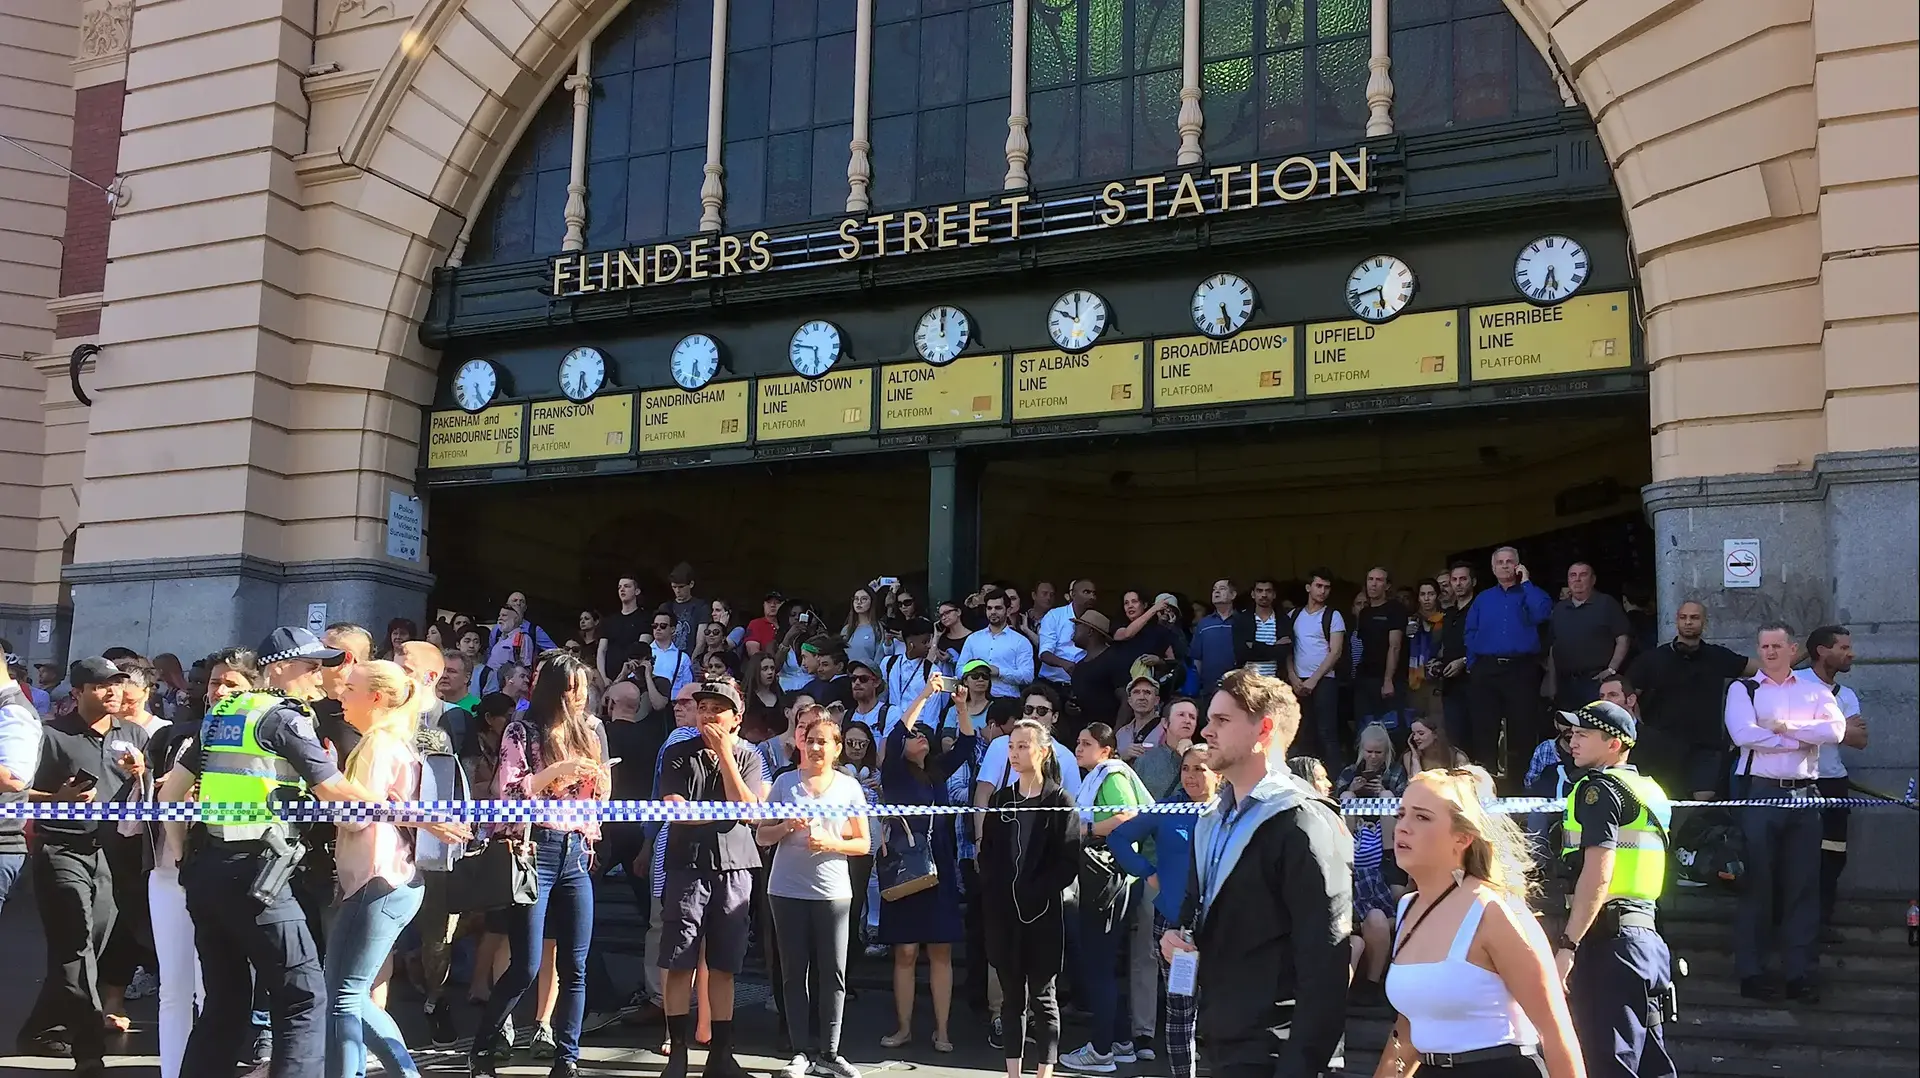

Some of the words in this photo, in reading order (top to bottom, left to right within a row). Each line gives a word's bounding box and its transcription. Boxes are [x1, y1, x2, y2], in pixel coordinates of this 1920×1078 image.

[553, 230, 773, 296] FLINDERS
[838, 195, 1030, 260] STREET
[1101, 147, 1368, 226] STATION
[1479, 306, 1563, 329] WERRIBEE
[1314, 326, 1375, 345] UPFIELD
[1479, 333, 1514, 350] LINE
[1160, 335, 1283, 360] BROADMEADOWS
[1019, 359, 1035, 373] ST
[1038, 355, 1089, 371] ALBANS
[1314, 348, 1346, 365] LINE
[1480, 353, 1541, 369] PLATFORM
[888, 368, 936, 384] ALTONA
[1161, 363, 1191, 379] LINE
[1314, 370, 1370, 384] PLATFORM
[765, 377, 852, 397] WILLIAMSTOWN
[1019, 377, 1047, 392] LINE
[1161, 383, 1213, 397] PLATFORM
[1569, 382, 1588, 391] FOR
[645, 389, 725, 409] SANDRINGHAM
[887, 388, 913, 402] LINE
[1019, 396, 1068, 409] PLATFORM
[533, 404, 594, 420] FRANKSTON
[763, 400, 788, 414] LINE
[887, 407, 933, 419] PLATFORM
[433, 414, 480, 429] PAKENHAM
[484, 413, 499, 425] and
[645, 412, 669, 426] LINE
[762, 419, 806, 431] PLATFORM
[432, 429, 492, 445] CRANBOURNE
[494, 427, 519, 440] LINES
[532, 423, 555, 437] LINE
[645, 431, 686, 442] PLATFORM
[431, 449, 468, 460] PLATFORM
[532, 441, 571, 452] PLATFORM
